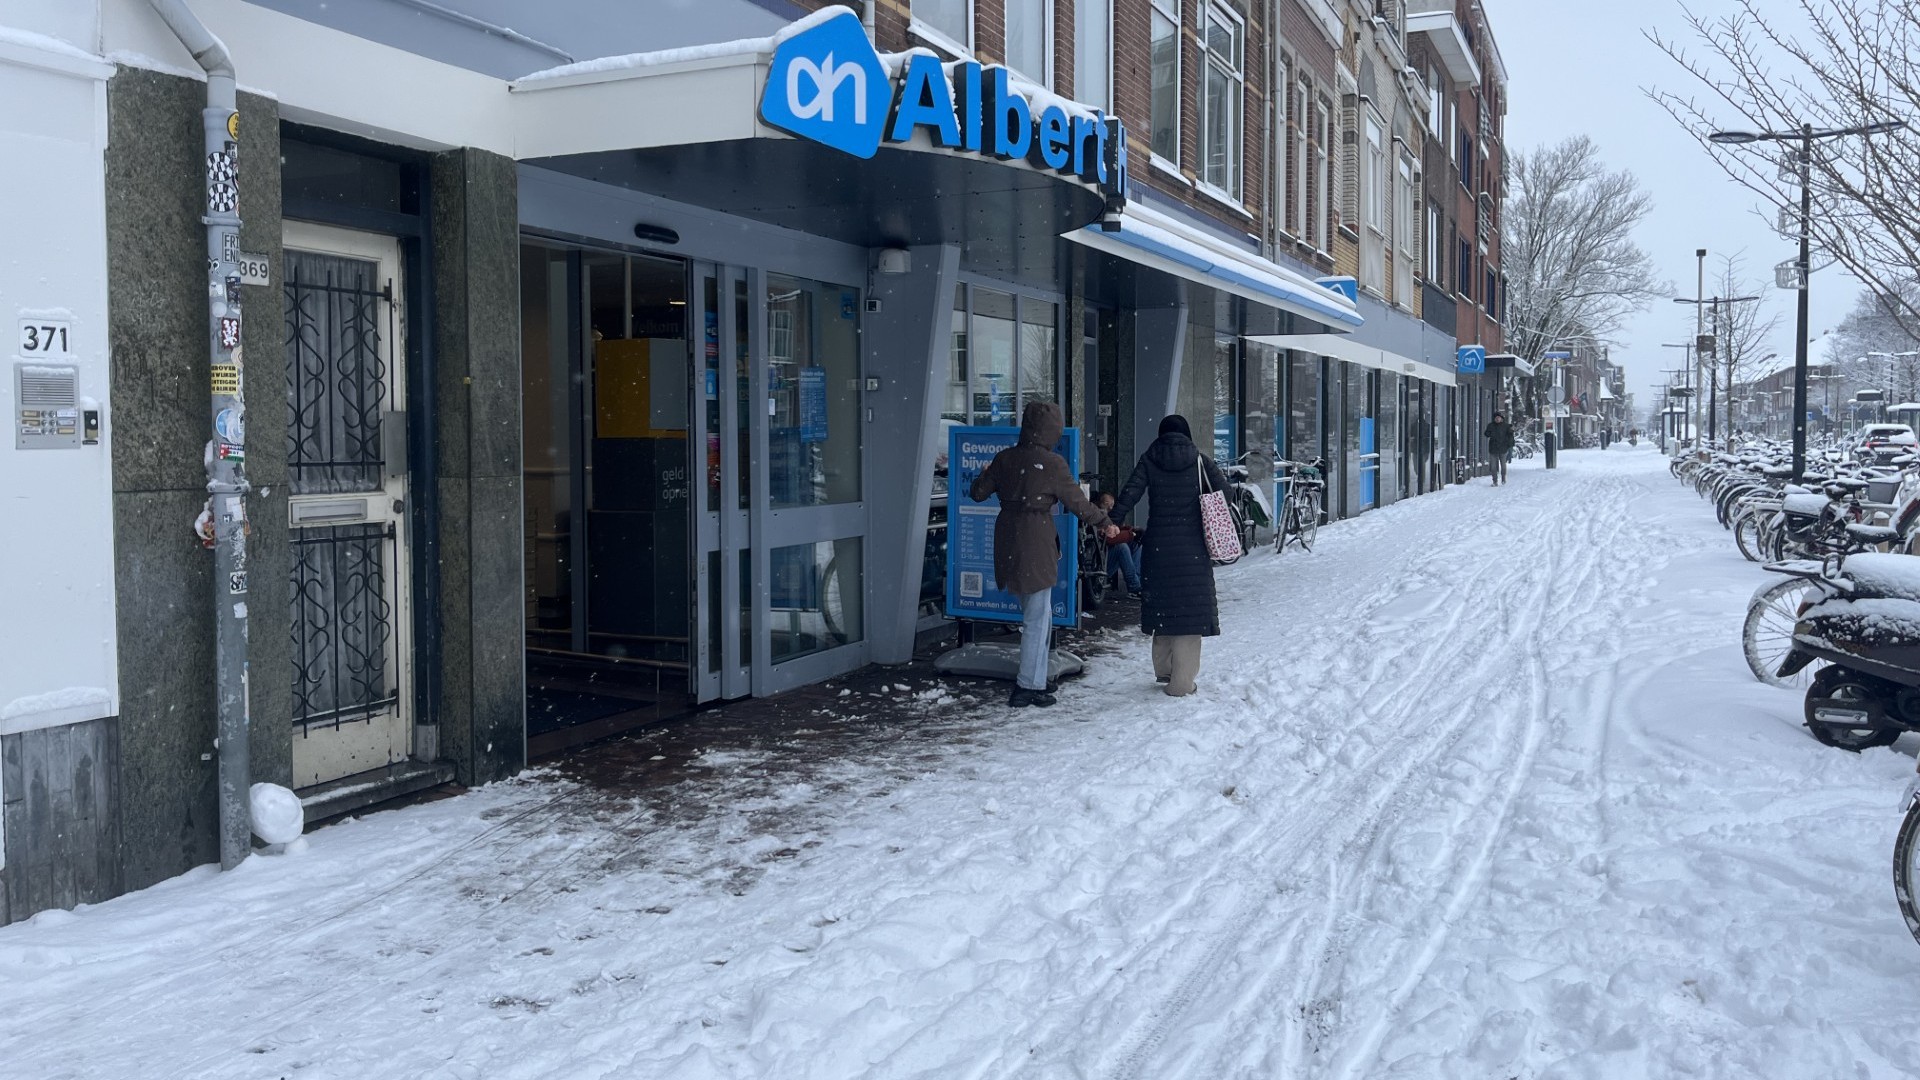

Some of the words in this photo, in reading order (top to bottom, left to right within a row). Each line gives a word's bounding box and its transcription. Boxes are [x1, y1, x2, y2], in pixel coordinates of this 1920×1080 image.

[892, 55, 1108, 184] Albert
[240, 260, 268, 279] 369
[23, 325, 68, 352] 371
[662, 466, 684, 485] geld
[959, 598, 974, 606] Kom
[975, 600, 1000, 609] werken
[1001, 601, 1008, 609] in
[1008, 602, 1017, 610] de
